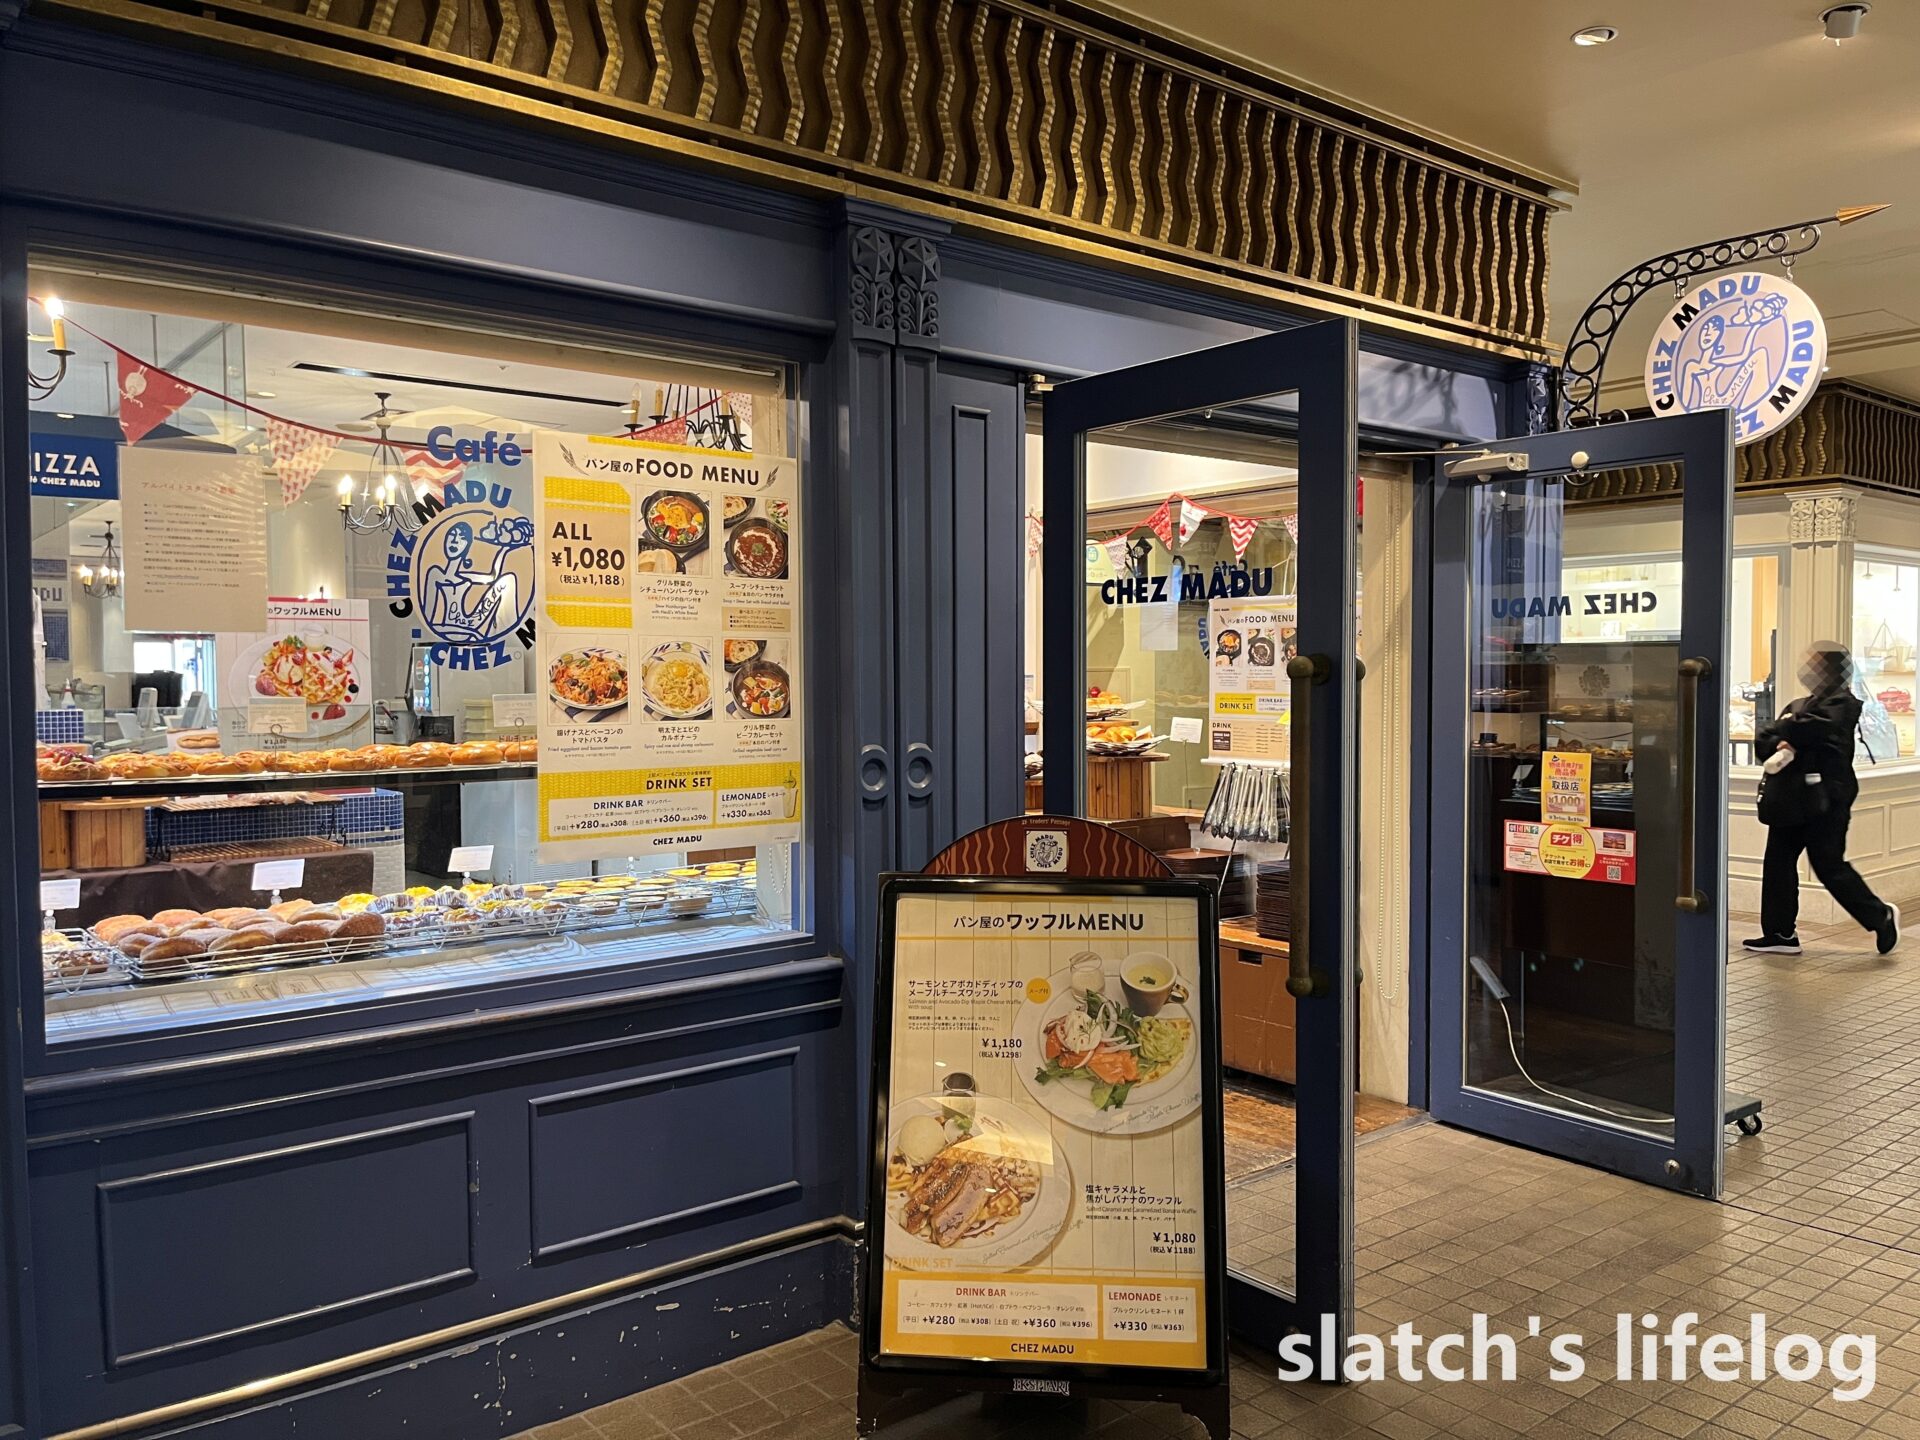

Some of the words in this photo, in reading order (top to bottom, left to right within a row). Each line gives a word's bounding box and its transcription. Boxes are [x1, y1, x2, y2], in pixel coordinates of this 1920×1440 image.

[1653, 338, 1677, 411] CHEZ
[1672, 275, 1761, 331] MADU
[1734, 409, 1765, 439] EZ
[1768, 319, 1815, 413] MADU
[427, 426, 522, 467] Café
[34, 452, 100, 476] IZZA
[702, 465, 759, 486] MENU
[41, 477, 67, 486] CHEZ
[70, 479, 100, 487] MADU
[552, 521, 592, 541] ALL
[387, 528, 418, 618] CHEZ
[413, 481, 512, 526] MADU
[551, 546, 625, 572] ¥1,080
[1101, 576, 1168, 605] CHEZ
[1180, 567, 1273, 600] MADU
[1270, 615, 1294, 623] MENU
[430, 640, 512, 671] CHEZ
[646, 779, 687, 790] DRINK
[692, 777, 712, 788] SET
[1552, 780, 1580, 791] 取扱店
[721, 792, 767, 801] LEMONADE
[593, 801, 623, 810] DRINK
[626, 799, 643, 808] BAR
[653, 837, 673, 846] CHEZ
[676, 835, 702, 844] MADU
[908, 980, 1023, 989] サーモンとアボカドディップの
[982, 1038, 1022, 1050] ¥1,180
[1086, 1184, 1146, 1194] 塩キャラメルと
[1153, 1232, 1196, 1245] ¥1,080
[933, 1258, 953, 1268] SET
[956, 1287, 985, 1296] DRINK
[987, 1288, 1007, 1297] BAR
[1108, 1292, 1162, 1302] LEMONADE
[922, 1315, 955, 1325] +¥280
[1023, 1318, 1056, 1328] +¥360
[1113, 1321, 1147, 1331] +¥330
[1011, 1343, 1039, 1353] CHEZ
[1041, 1344, 1074, 1354] MADU
